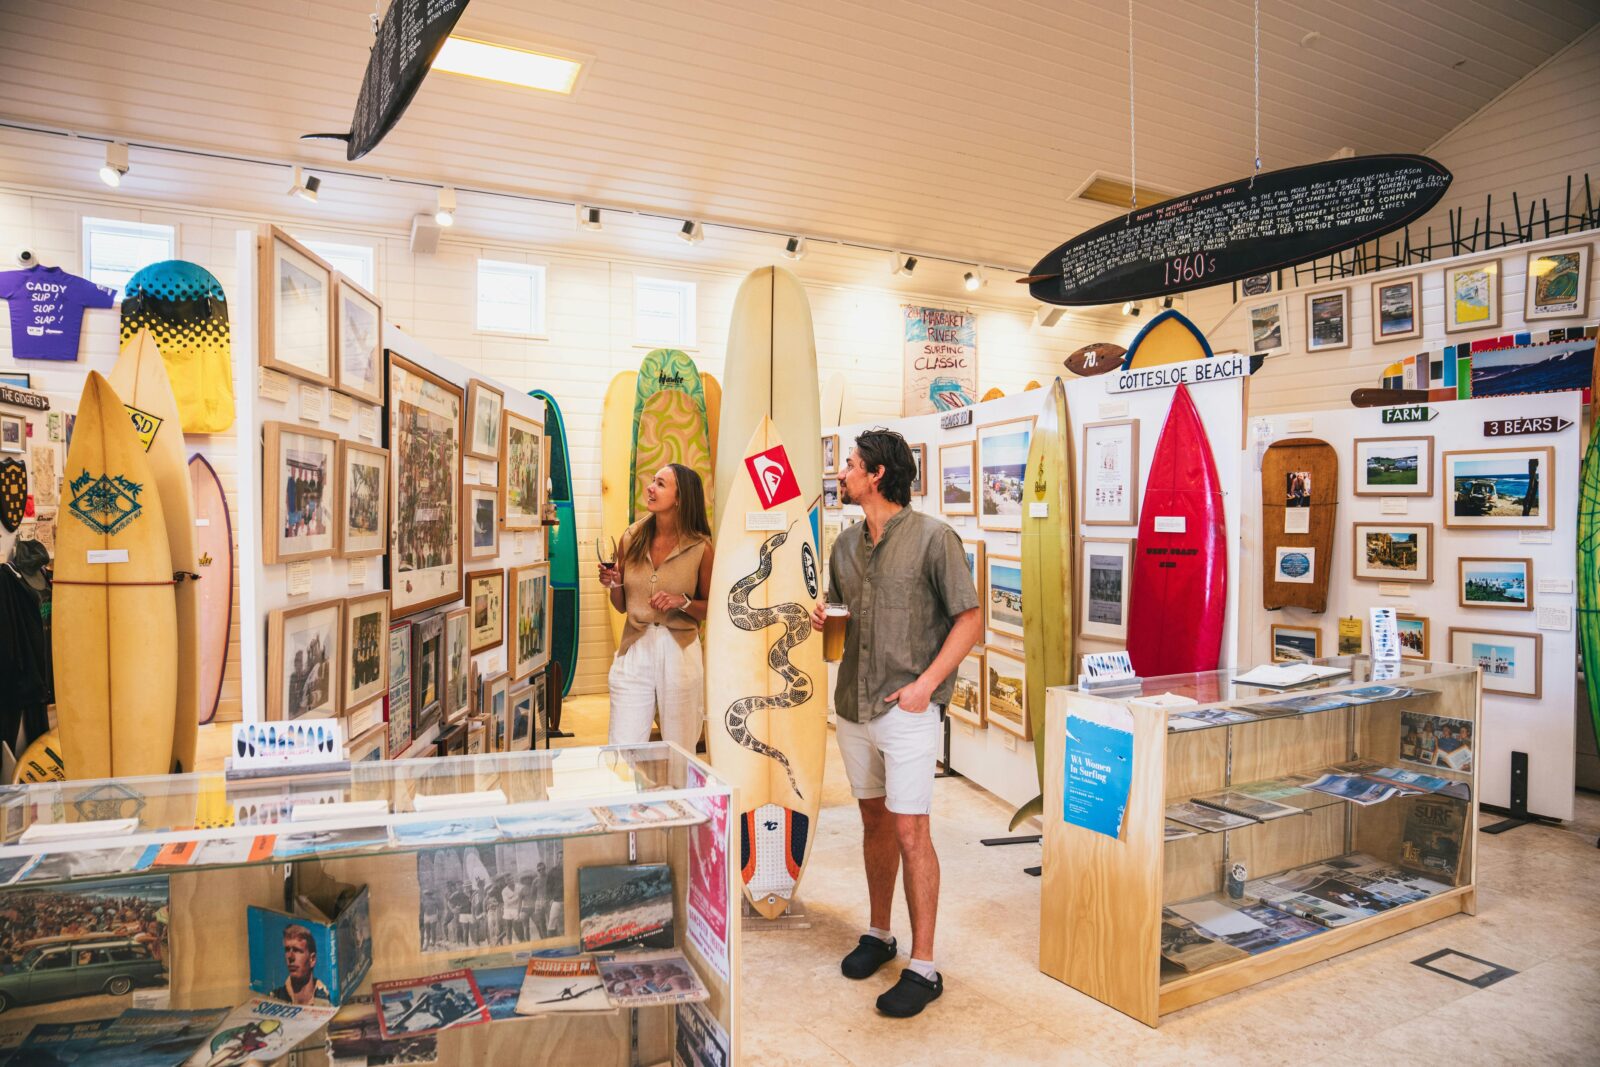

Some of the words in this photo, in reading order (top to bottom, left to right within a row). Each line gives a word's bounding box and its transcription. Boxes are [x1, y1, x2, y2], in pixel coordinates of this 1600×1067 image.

[443, 1, 456, 14] ROSE
[1195, 206, 1217, 215] MAGPIES
[1352, 173, 1389, 182] CHANGING
[1306, 193, 1335, 202] STARTING
[1379, 178, 1423, 189] ADRENALINE
[1292, 203, 1319, 213] SURFING
[1377, 185, 1411, 196] JOURNEY
[1232, 221, 1255, 229] WAITING
[1294, 209, 1326, 218] WEATHER
[1330, 201, 1358, 211] REPORT
[1379, 192, 1416, 202] CONFIRM
[1336, 206, 1374, 218] CORDUROY
[1380, 200, 1404, 209] LINES
[1206, 236, 1227, 245] NATURE
[1149, 253, 1164, 261] FROM
[26, 282, 67, 293] CADDY
[32, 293, 50, 301] SLIP
[33, 304, 55, 312] SLOP
[34, 316, 56, 324] SLAP
[923, 309, 964, 328] MARGARET
[928, 327, 958, 342] RIVER
[924, 345, 964, 354] SURFING
[914, 357, 968, 370] CLASSIC
[1120, 366, 1188, 390] COTTESLOE
[1196, 358, 1242, 380] BEACH
[2, 388, 14, 402] THE
[14, 392, 40, 408] GIDGETS
[1386, 408, 1422, 422] FARM
[1490, 422, 1498, 435] 3
[1504, 418, 1552, 434] BEARS
[1070, 754, 1082, 766] WA
[1085, 757, 1111, 773] Women
[1070, 764, 1078, 774] In
[1080, 766, 1107, 784] Surfing
[1414, 806, 1454, 820] SURF
[531, 969, 580, 977] PHOTOGRAPHY
[534, 960, 578, 972] SURFER
[252, 1001, 302, 1019] SURFER
